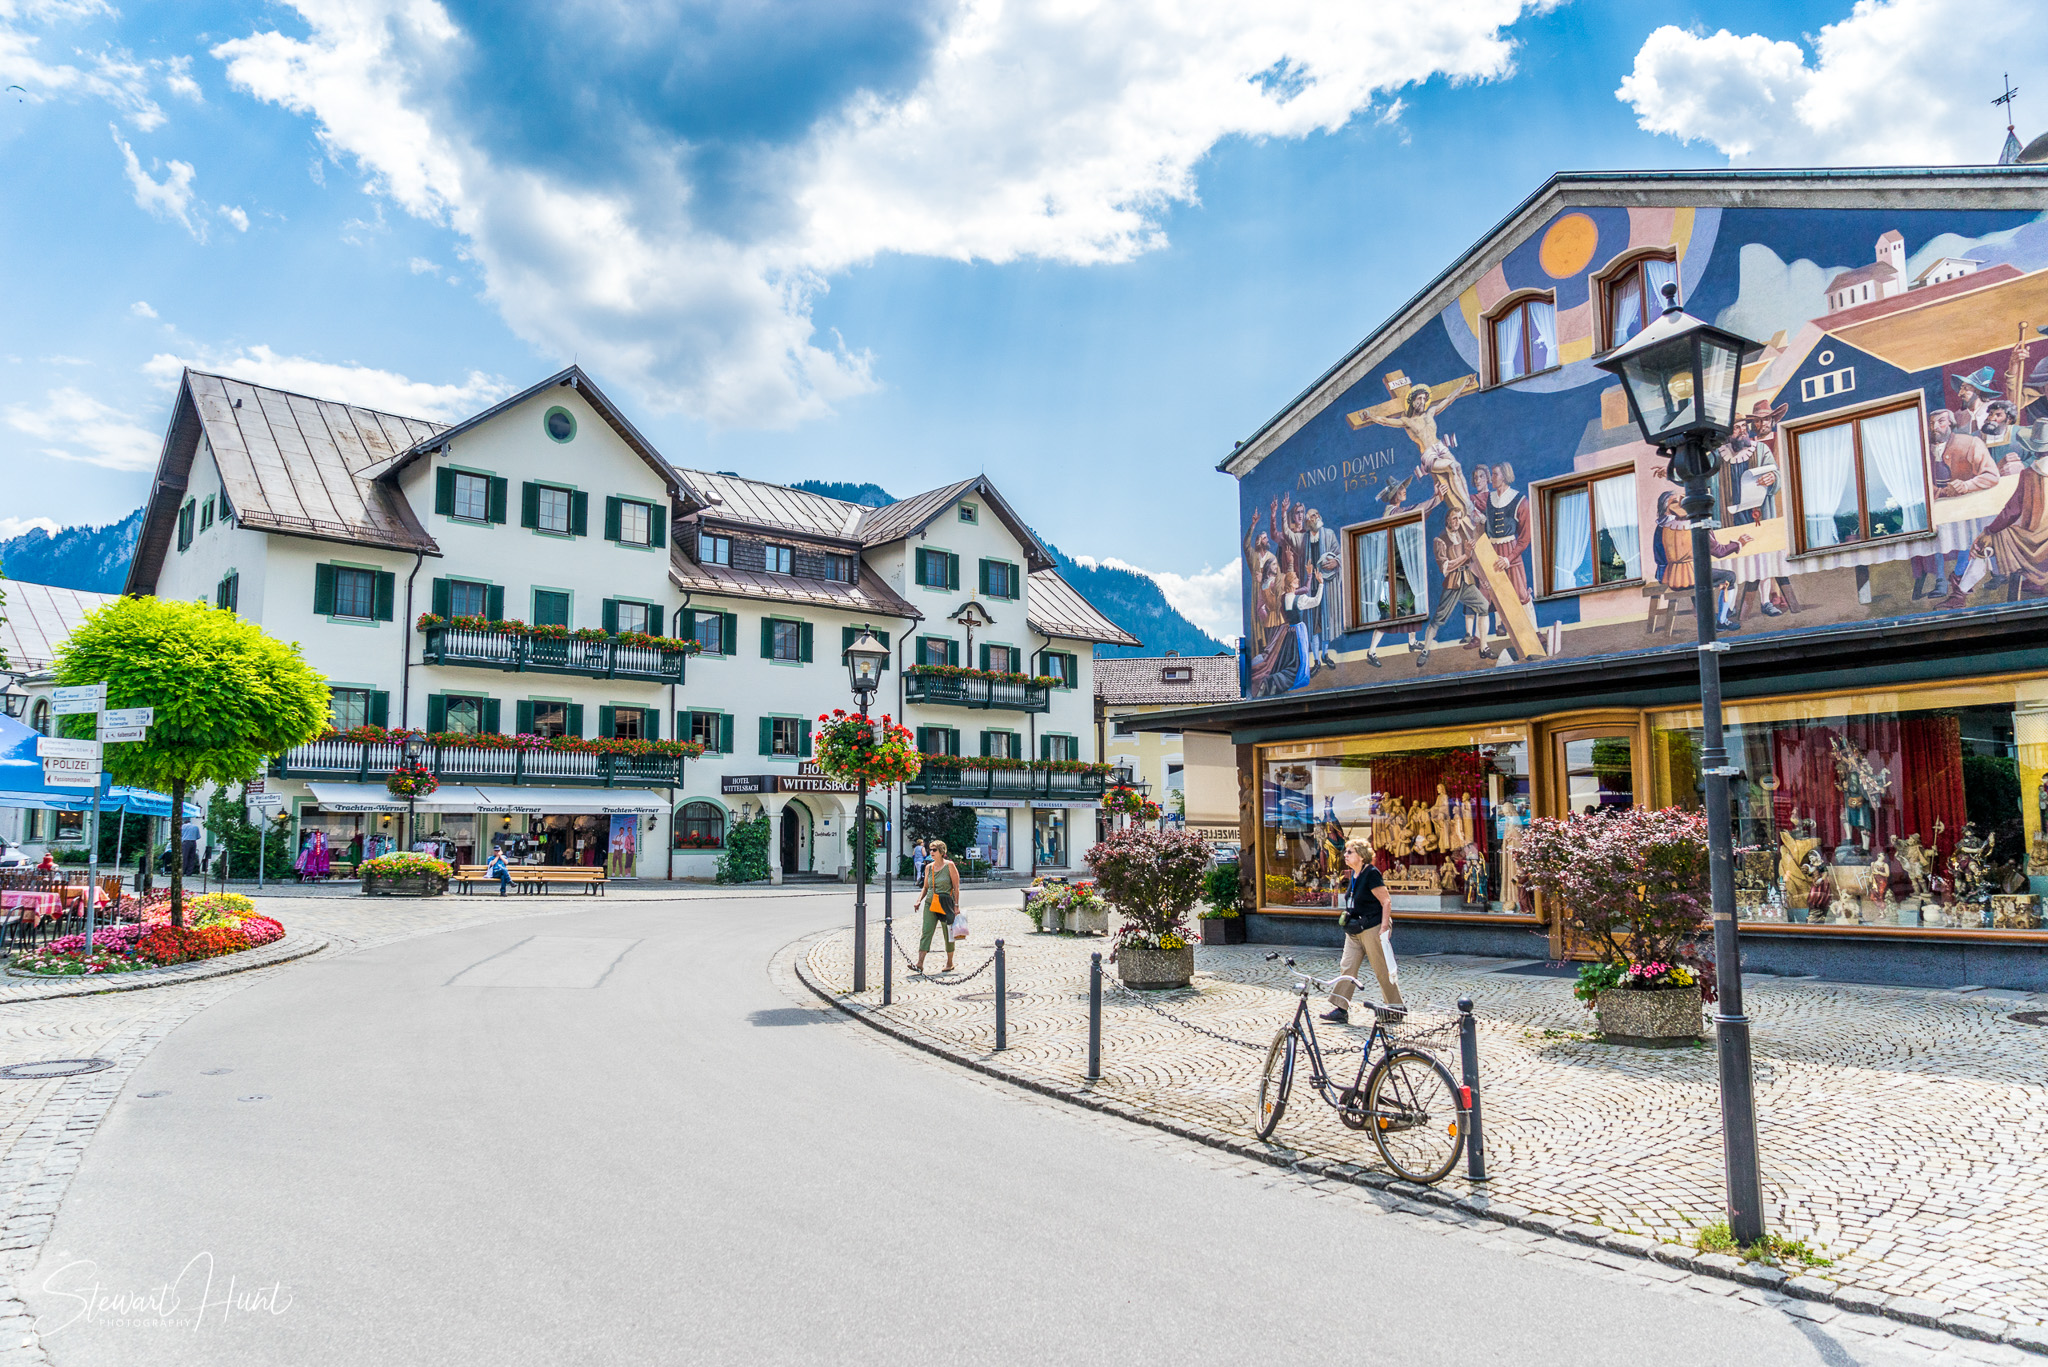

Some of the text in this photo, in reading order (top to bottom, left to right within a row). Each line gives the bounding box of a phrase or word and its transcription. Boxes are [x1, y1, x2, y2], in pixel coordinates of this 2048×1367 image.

[1296, 447, 1395, 491] ANNO DOMINI
[53, 759, 89, 770] POLIZEI
[723, 784, 759, 792] WITTELSBACH
[783, 779, 859, 792] WITTELSBACH
[334, 804, 408, 812] Trachten-Werner
